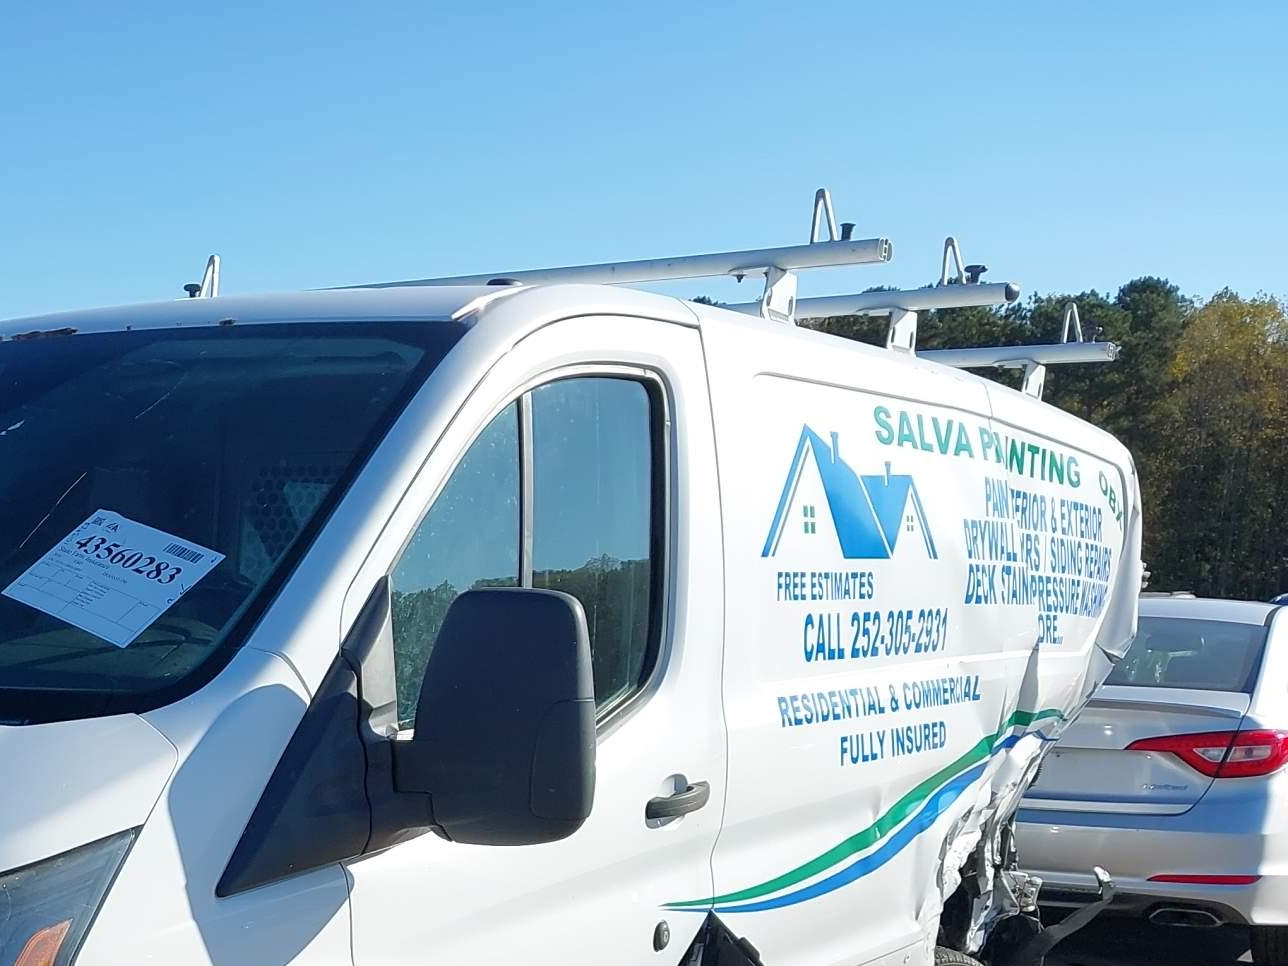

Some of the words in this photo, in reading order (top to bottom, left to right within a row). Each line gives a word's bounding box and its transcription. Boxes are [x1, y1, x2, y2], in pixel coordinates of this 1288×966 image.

[872, 406, 975, 459] SALVA
[962, 518, 1018, 563] DRYWALL
[1050, 536, 1083, 577] SIDING
[1059, 499, 1103, 543] EXTERIOR
[76, 535, 182, 584] 43560283
[777, 571, 807, 601] FREE
[810, 571, 875, 601] ESTIMATES
[964, 563, 998, 605] DECK
[1029, 574, 1082, 616] PRESSURE
[804, 612, 845, 663] CALL
[850, 607, 949, 659] 252-305-2931
[777, 685, 885, 728] RESIDENTIAL
[888, 683, 900, 713] &
[902, 675, 982, 711] COMMERCIAL
[840, 730, 886, 767] FULLY
[890, 720, 948, 758] INSURED
